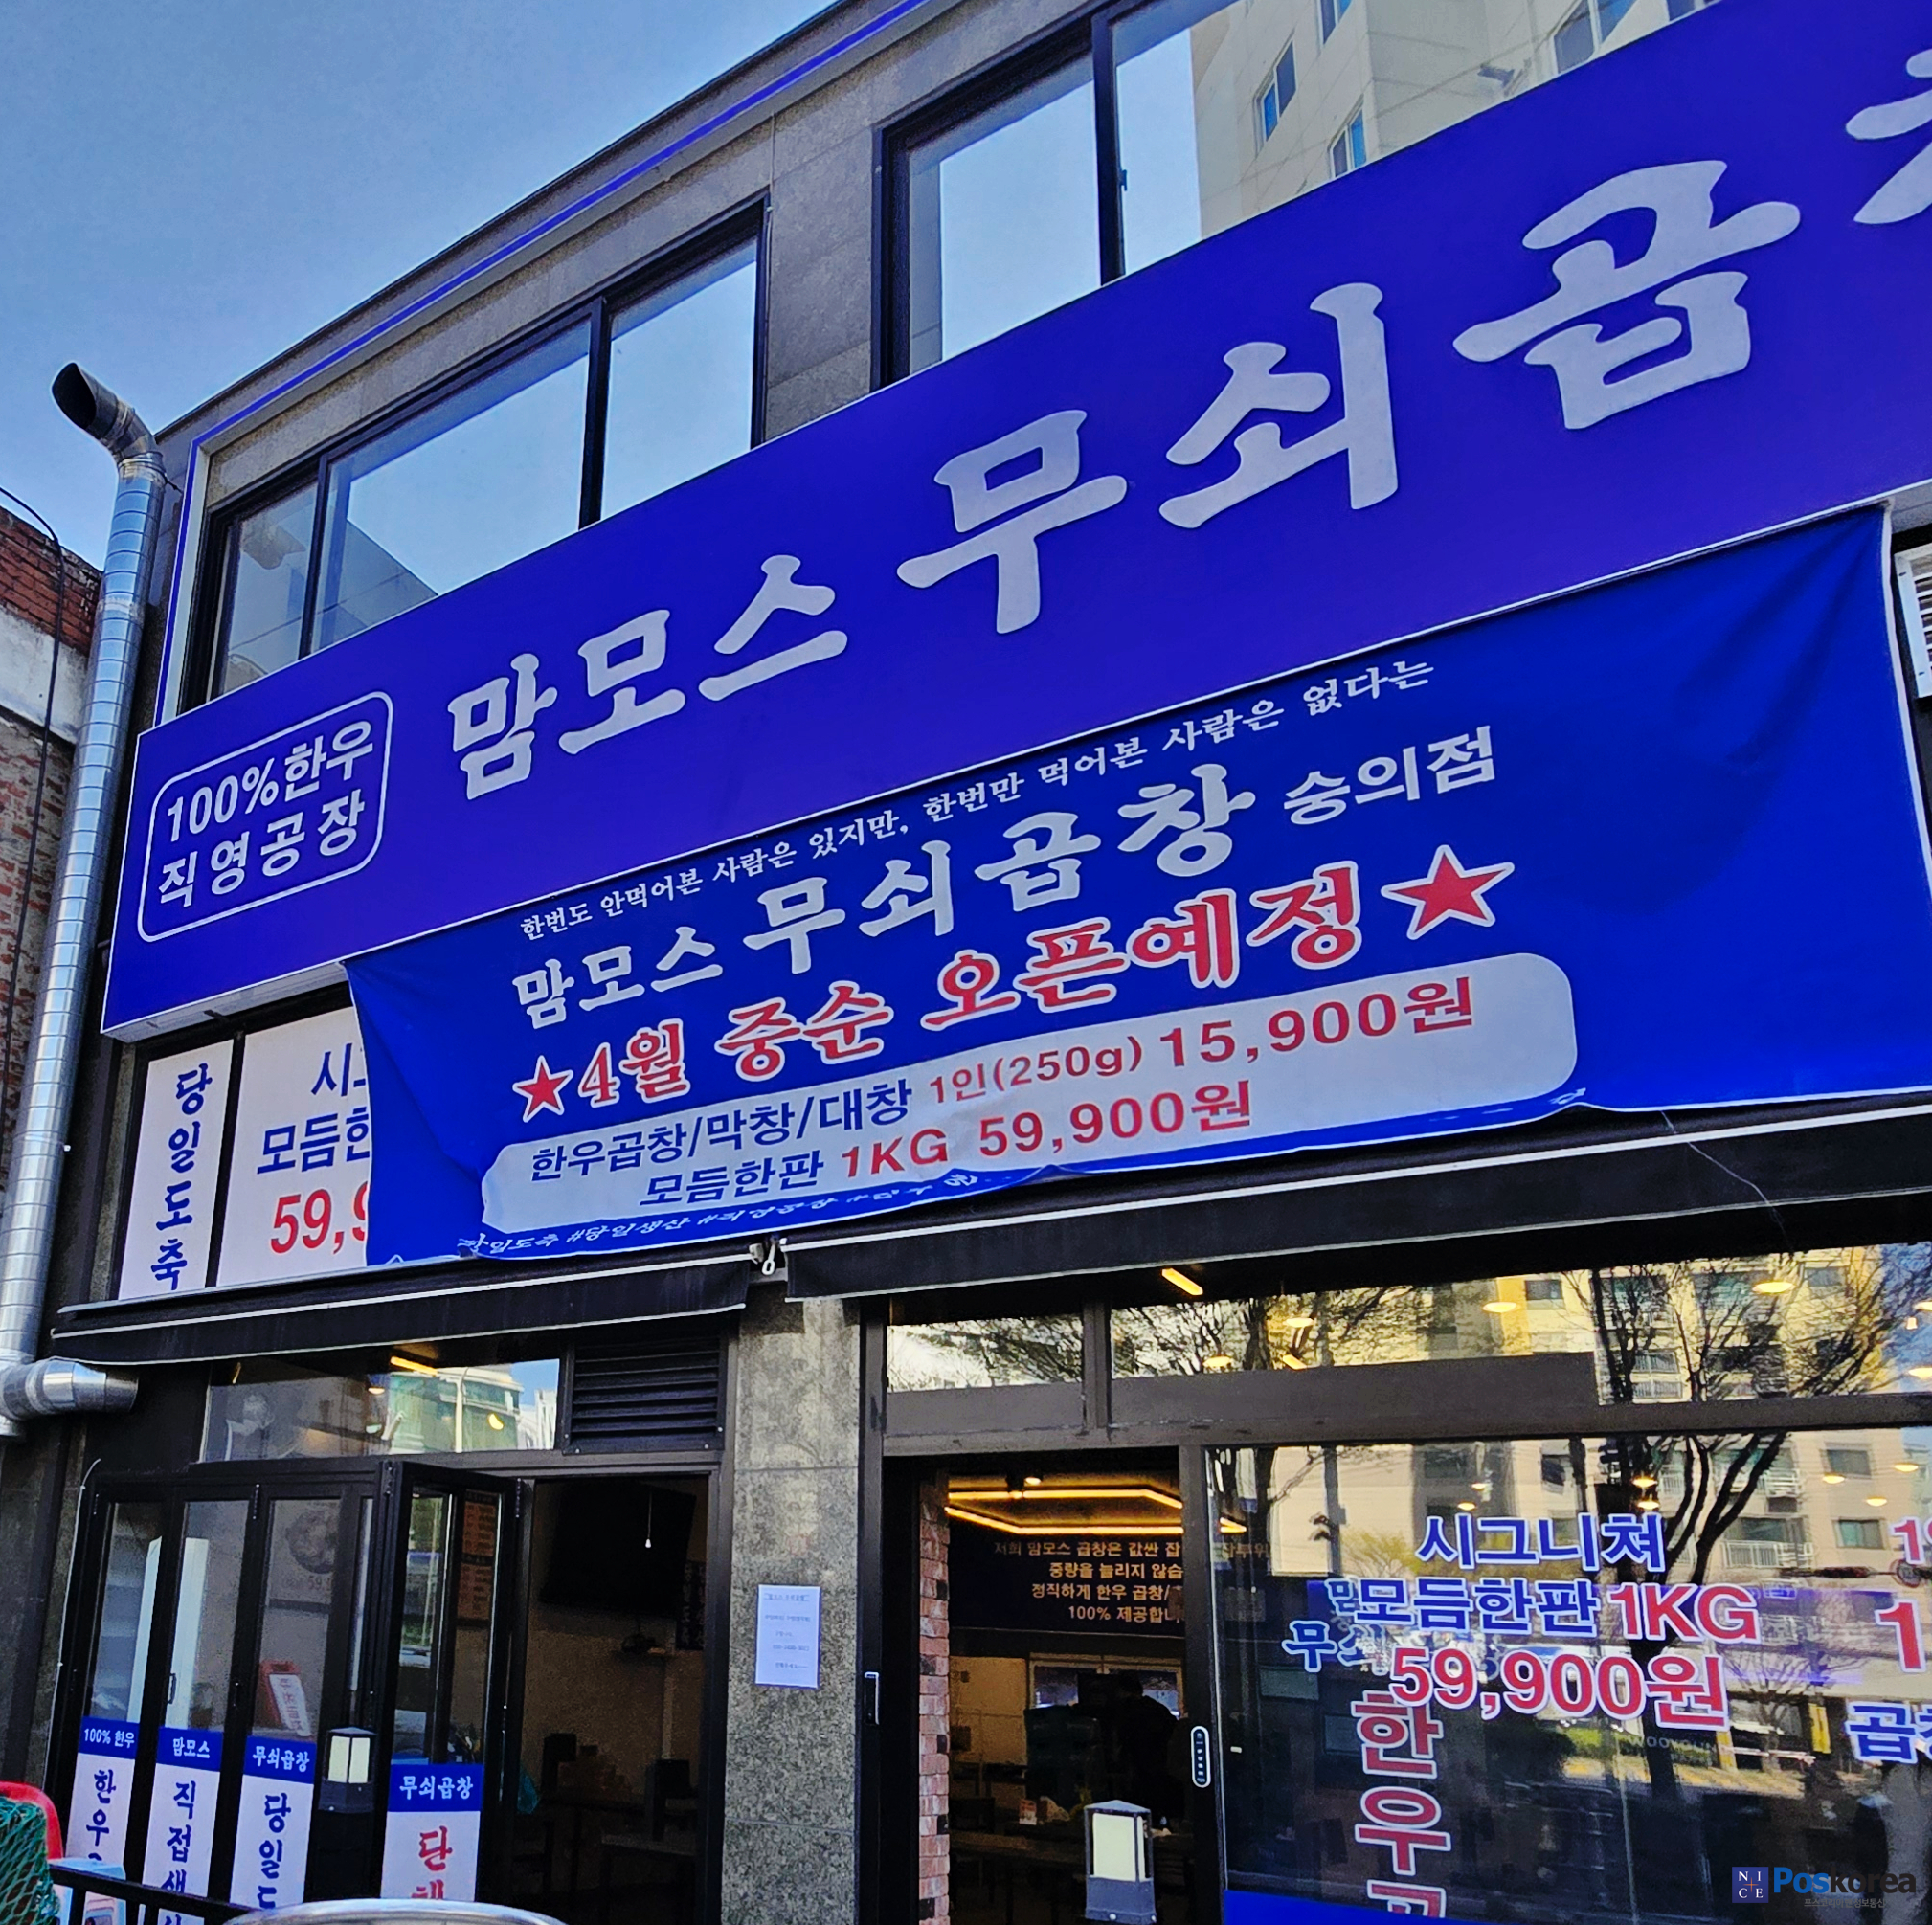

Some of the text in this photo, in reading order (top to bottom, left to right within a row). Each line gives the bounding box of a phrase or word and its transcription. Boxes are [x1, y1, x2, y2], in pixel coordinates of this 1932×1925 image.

[447, 48, 1932, 800] 맘모스 무쇠곱
[520, 660, 1434, 941] 한번도 안먹어본 사람은 있지만, 한번만 먹어본 사람은 없다는
[159, 788, 366, 907] 직영공장
[512, 926, 723, 1029] 맘모스
[1283, 725, 1495, 825] 숭의점
[578, 860, 1362, 1108] 4월 중순 오픈예정
[531, 975, 1473, 1183] 한우곱창/막창/대창 1인(250g) 15,900원
[640, 1150, 824, 1207] 모듬한판
[842, 1128, 949, 1179] 1KG
[978, 1079, 1252, 1157] 59,900원
[150, 1062, 213, 1291] 당일도축
[995, 1542, 1022, 1556] 저희
[1027, 1542, 1071, 1556] 맘모스
[1076, 1541, 1122, 1557] 곱창은
[1128, 1541, 1159, 1557] 값싼
[1048, 1562, 1093, 1579] 중량을
[1099, 1562, 1145, 1579] 늘리지
[1416, 1512, 1667, 1572] 시그니쳐
[1890, 1516, 1932, 1565] 1
[1031, 1583, 1183, 1601] 정직하게 한우 곱창/
[1068, 1605, 1111, 1621] 100%
[1354, 1577, 1600, 1637] 모듬한판
[1609, 1583, 1761, 1644] 1KG
[1388, 1646, 1729, 1731] 59,900원
[83, 1728, 135, 1749] 100% 한우
[172, 1736, 211, 1759] 맘모스
[252, 1745, 311, 1773] 무쇠곱창
[399, 1775, 474, 1801] 무쇠곱창
